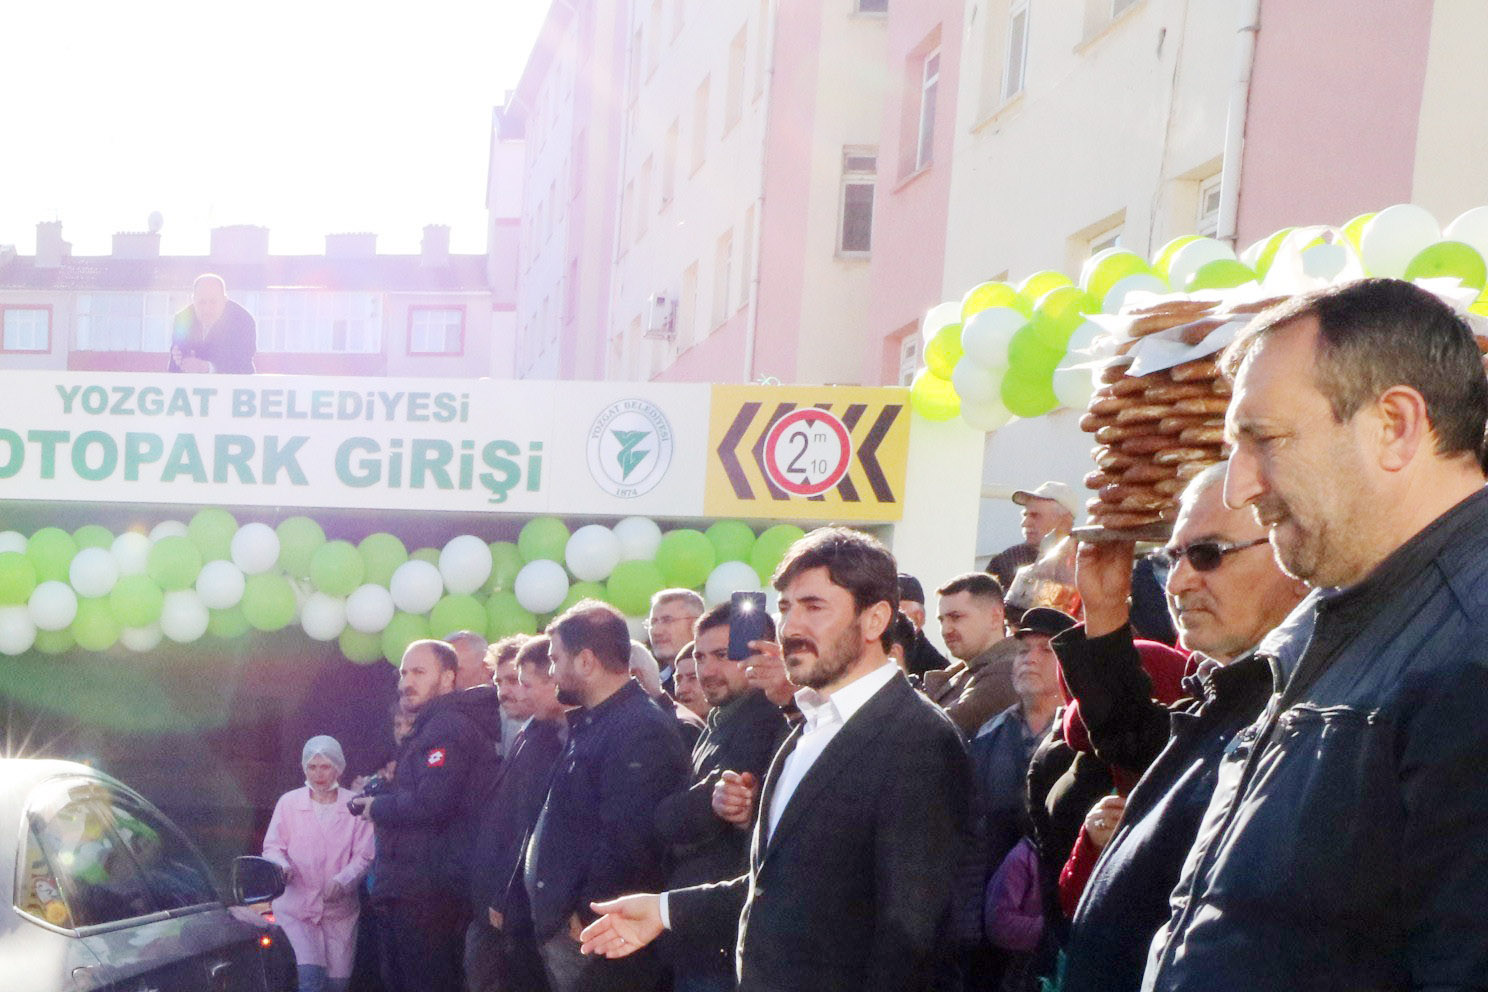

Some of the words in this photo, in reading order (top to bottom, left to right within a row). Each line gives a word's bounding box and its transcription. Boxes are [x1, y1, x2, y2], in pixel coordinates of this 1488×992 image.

[56, 385, 218, 417] YOZGAT
[592, 405, 621, 439] YOZGAT
[814, 433, 827, 443] m
[786, 431, 809, 474] 2
[811, 459, 828, 475] 10
